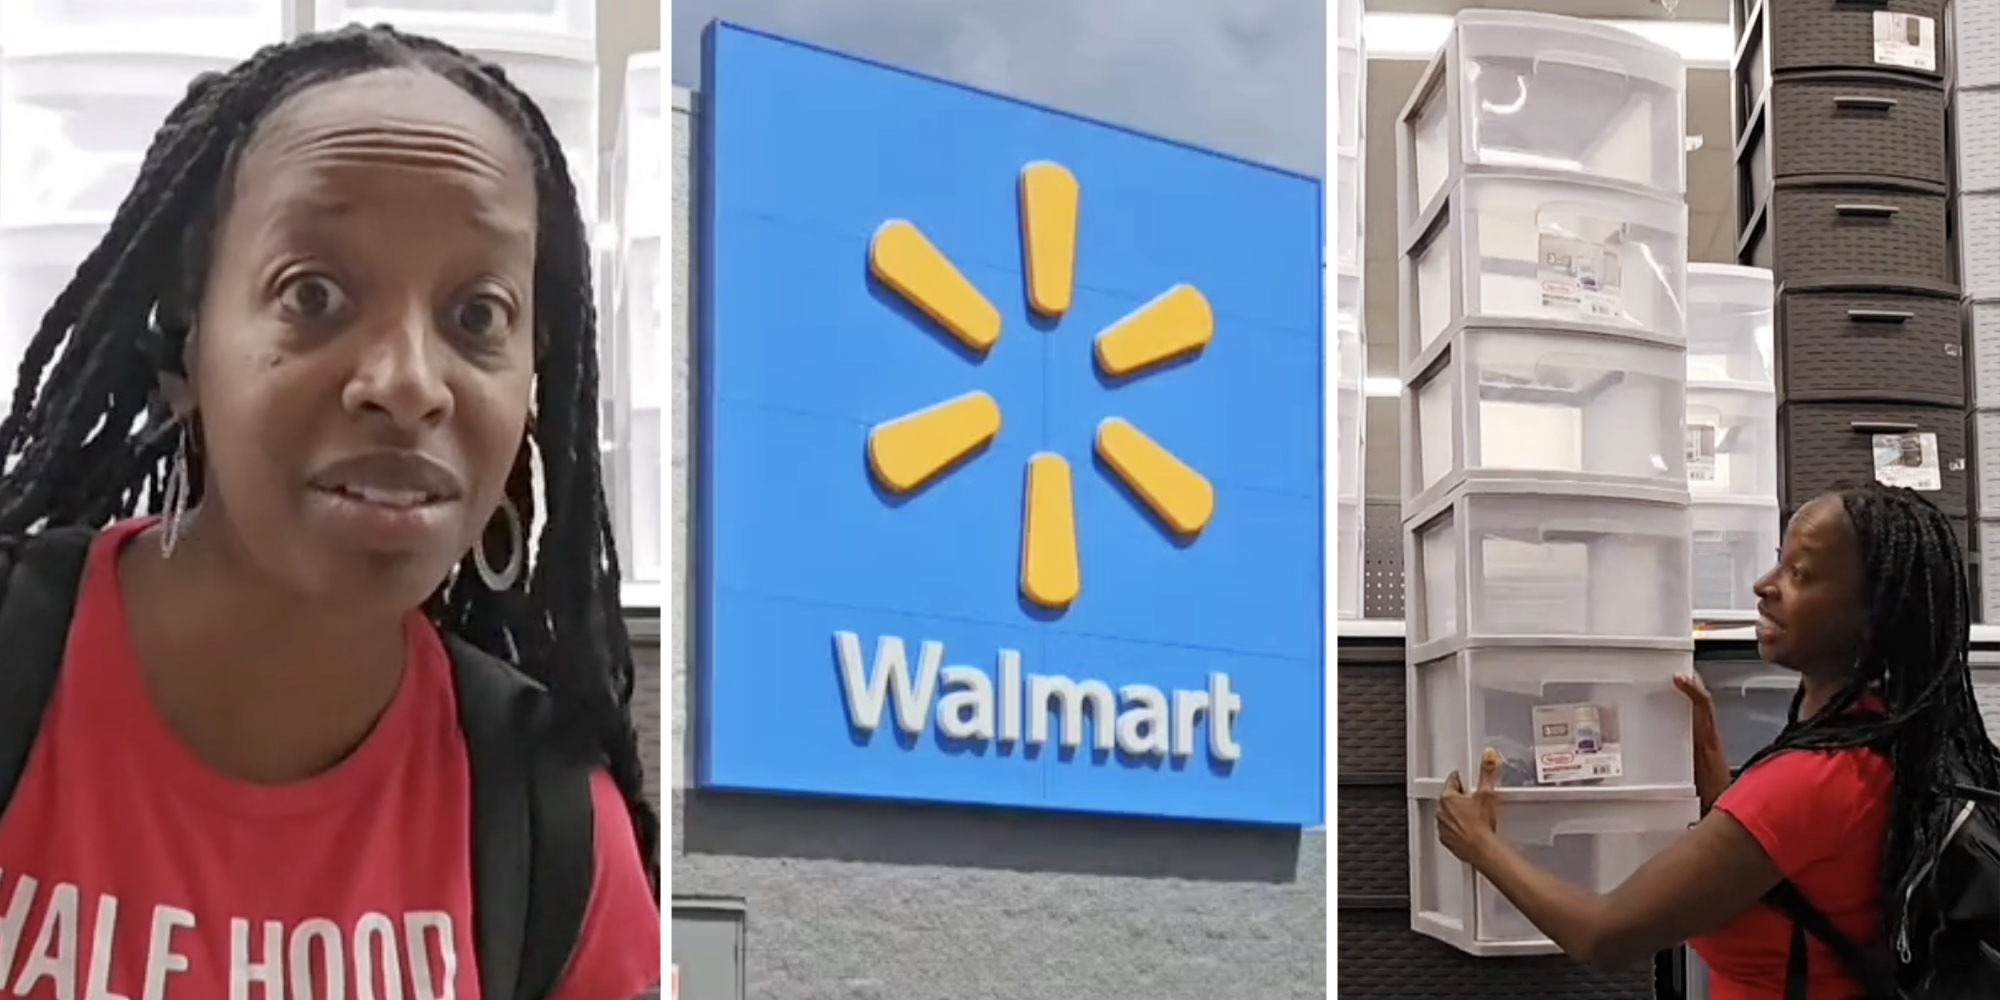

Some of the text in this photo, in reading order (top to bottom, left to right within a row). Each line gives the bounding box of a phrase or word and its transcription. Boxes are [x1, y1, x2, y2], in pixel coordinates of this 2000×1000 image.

[833, 631, 1241, 762] Walmart
[0, 867, 456, 1000] HALF HOOD
